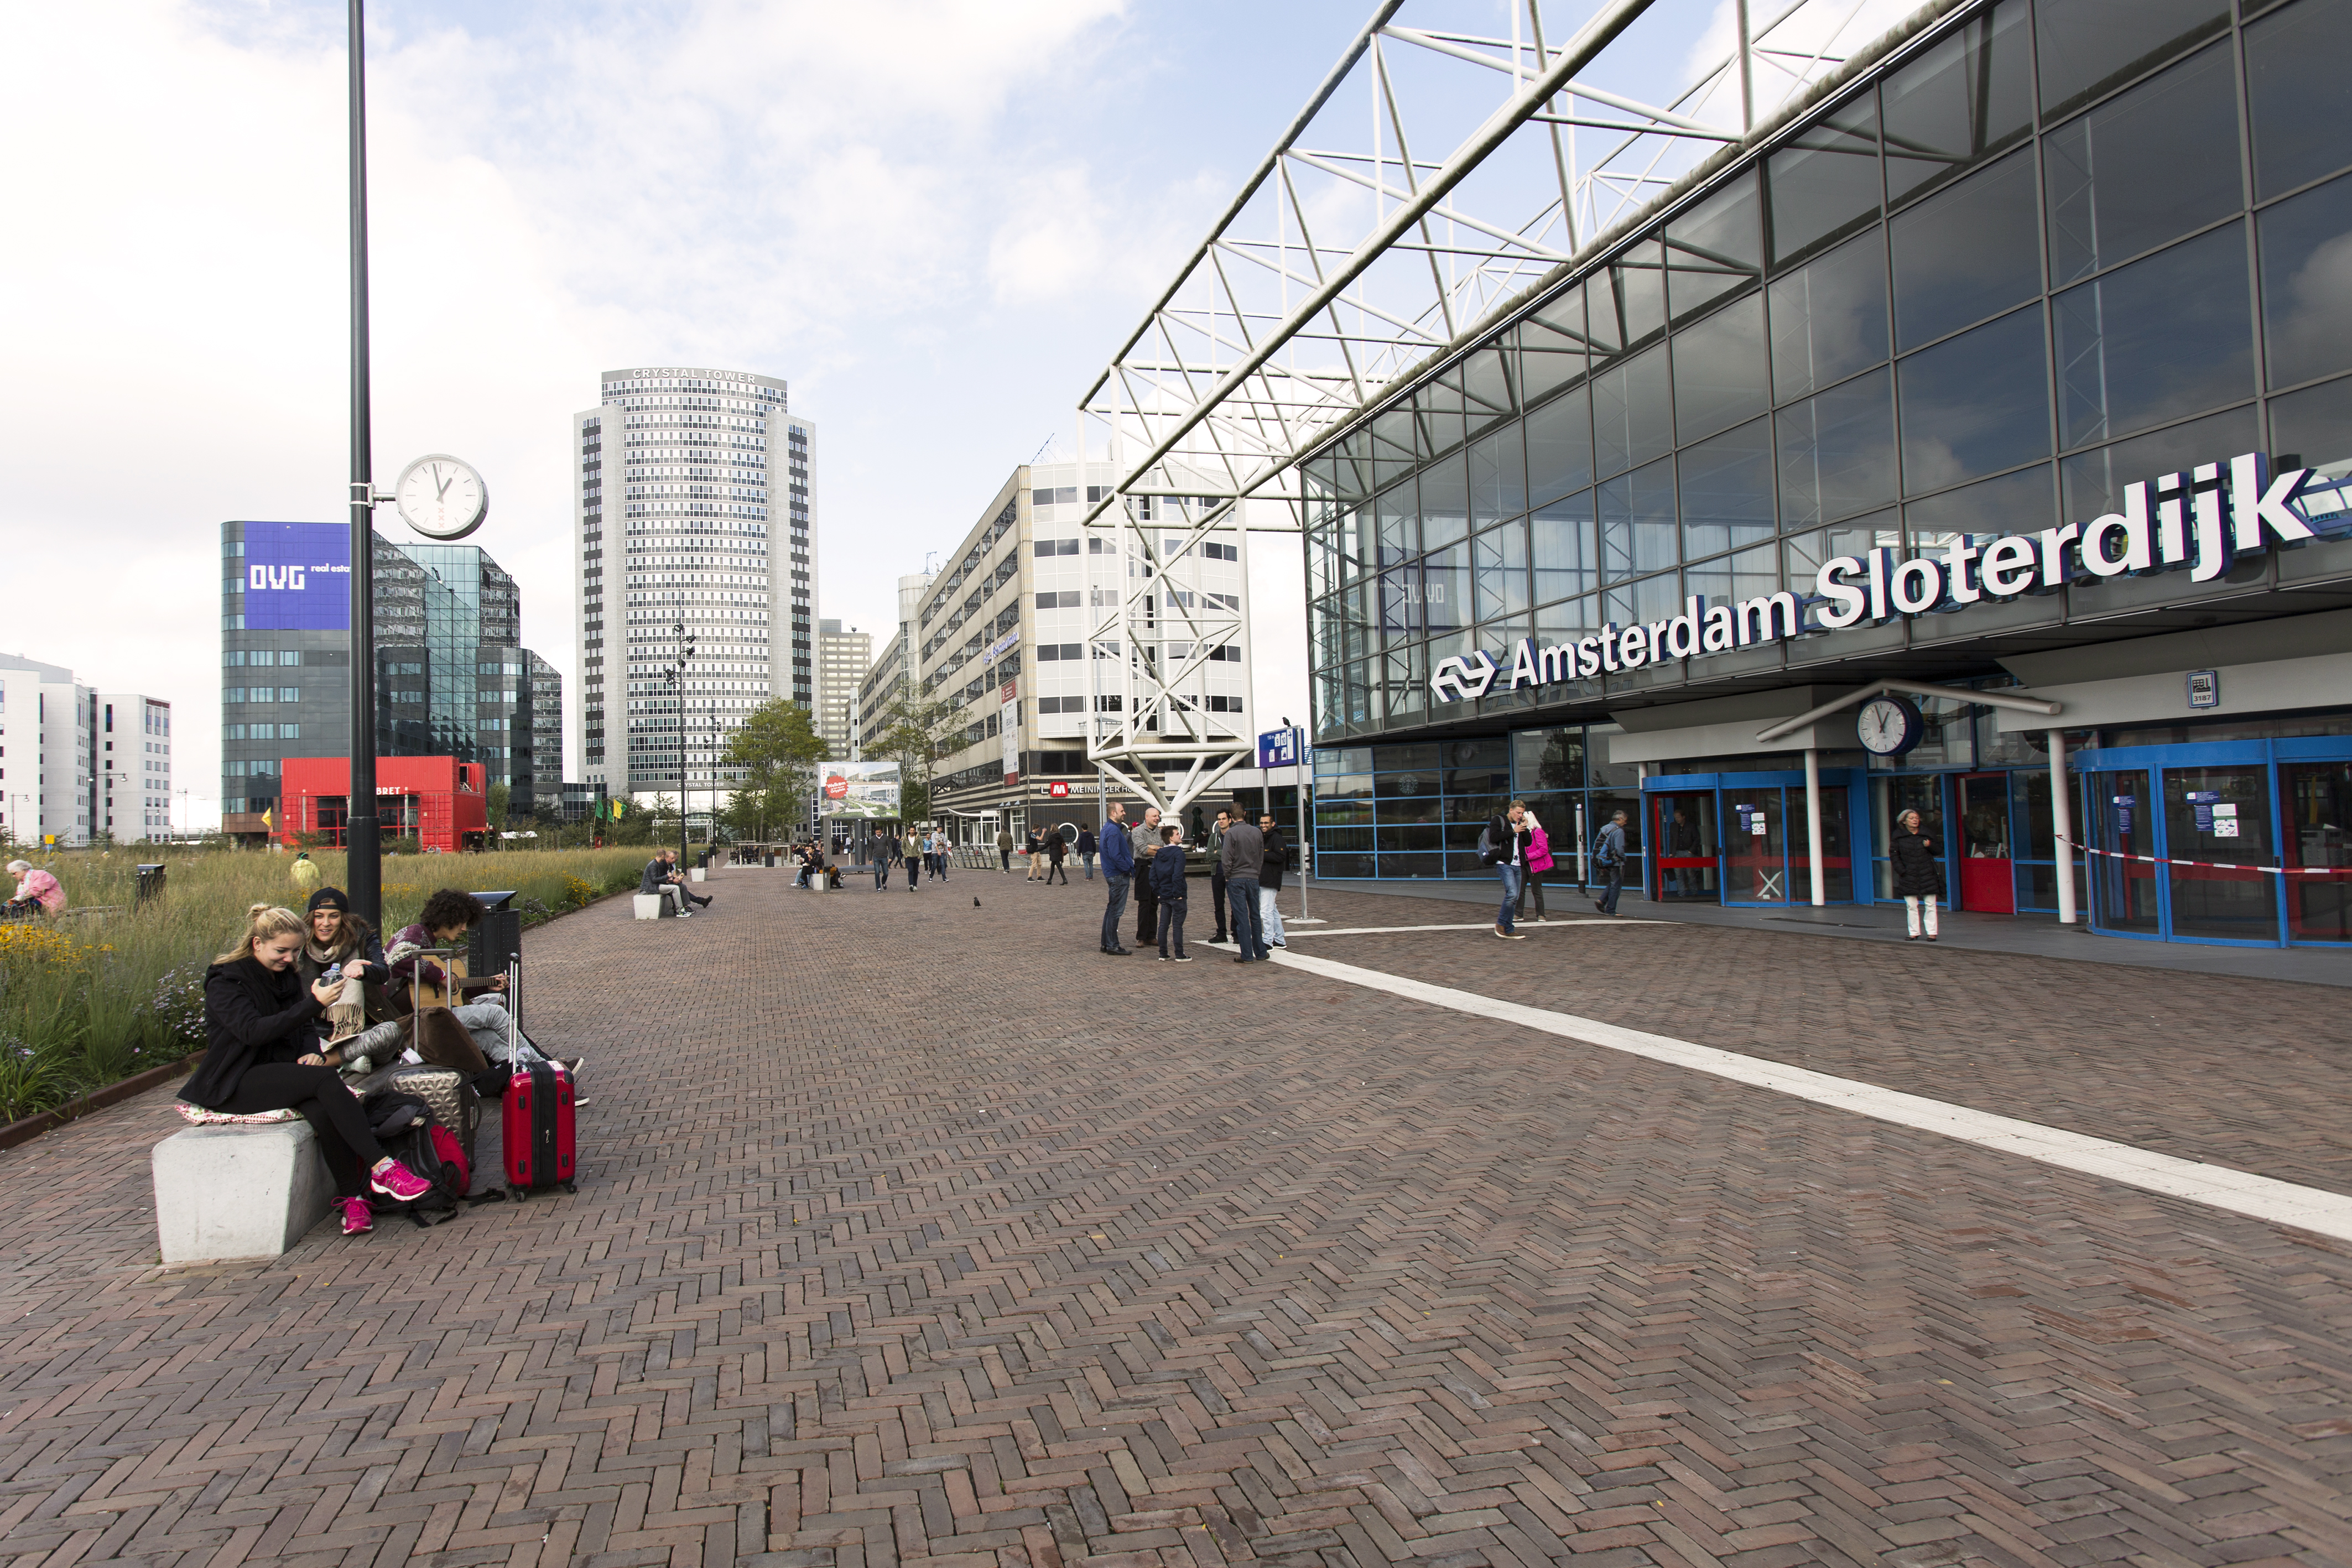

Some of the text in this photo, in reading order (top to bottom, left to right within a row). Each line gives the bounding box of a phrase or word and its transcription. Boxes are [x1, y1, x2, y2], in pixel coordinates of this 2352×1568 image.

[633, 368, 756, 384] CRYSTAL TOWER
[251, 565, 305, 590] OVG
[311, 563, 329, 572] real
[1510, 452, 2319, 690] Amsterdam Sloterdijk
[376, 786, 400, 795] BRET
